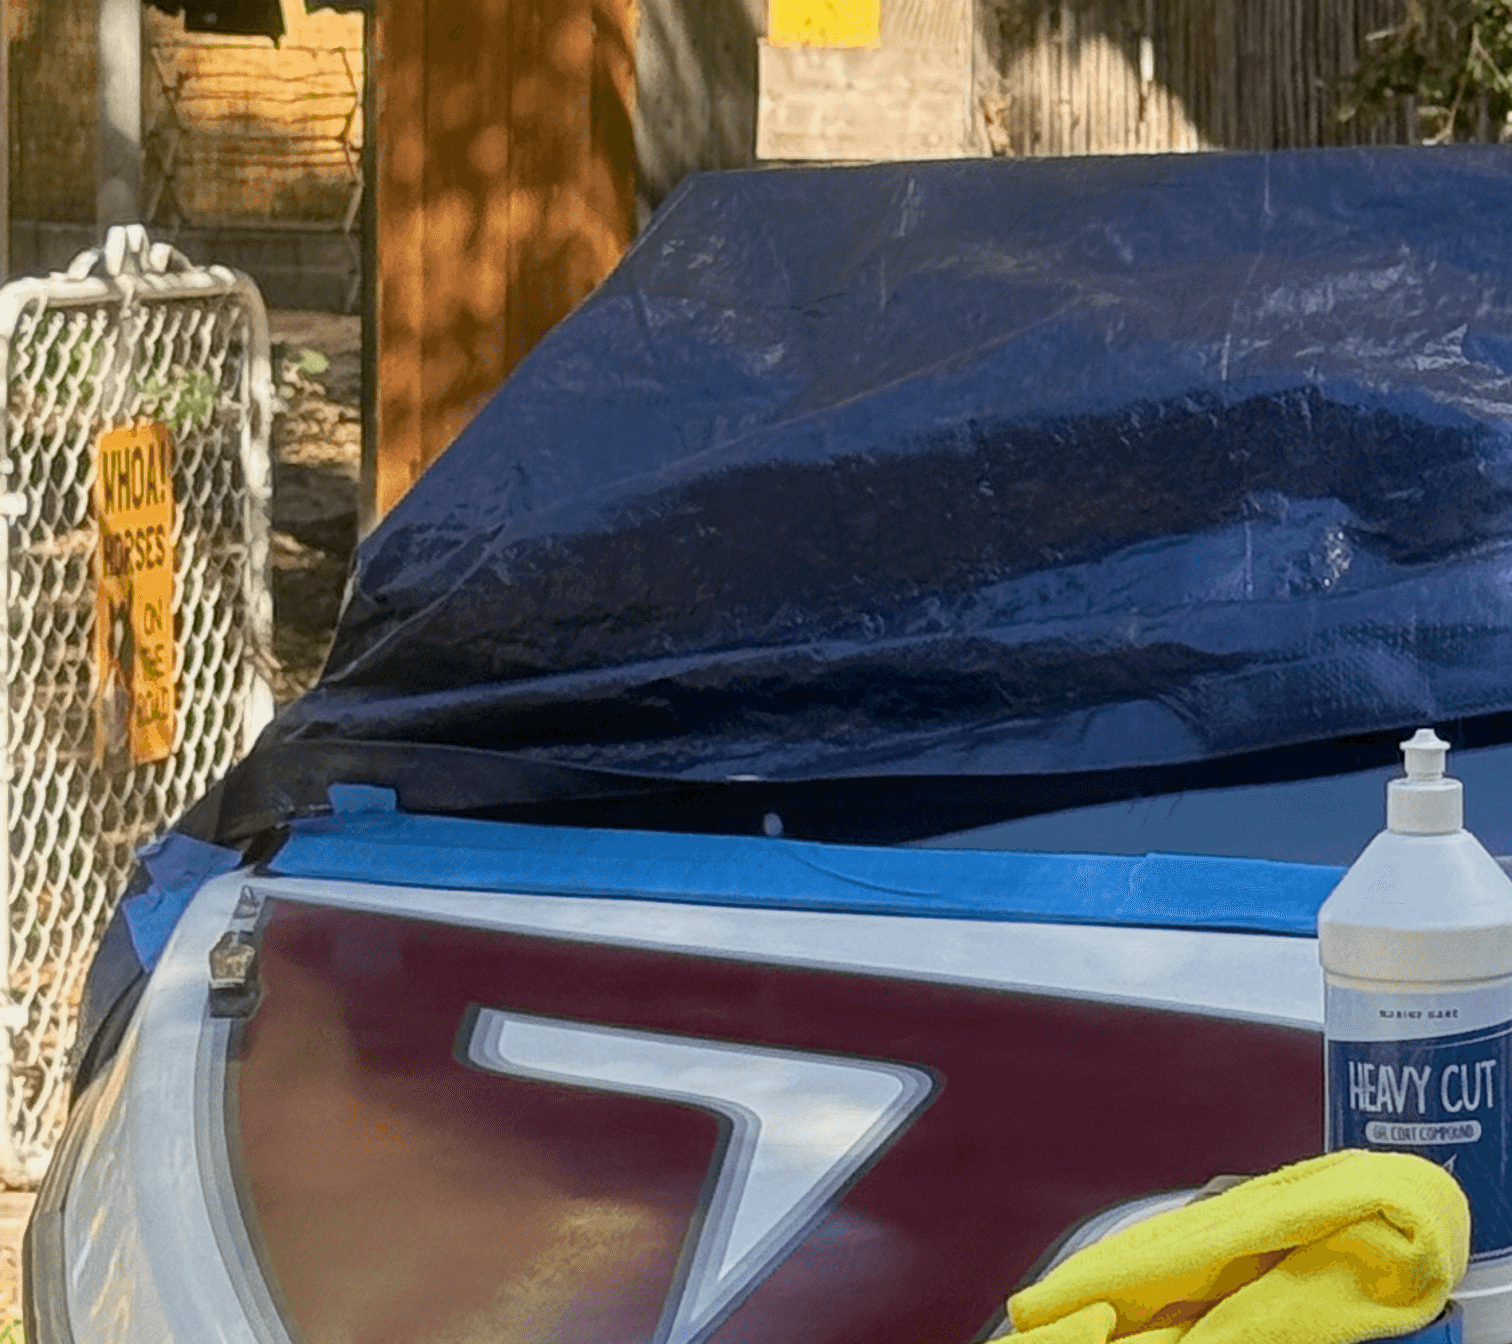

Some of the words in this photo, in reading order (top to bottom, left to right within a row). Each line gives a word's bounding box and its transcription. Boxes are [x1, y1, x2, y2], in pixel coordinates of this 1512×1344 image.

[102, 441, 166, 513] WHOA!
[1349, 1060, 1432, 1114] HEAVY
[1441, 1059, 1497, 1113] CUT
